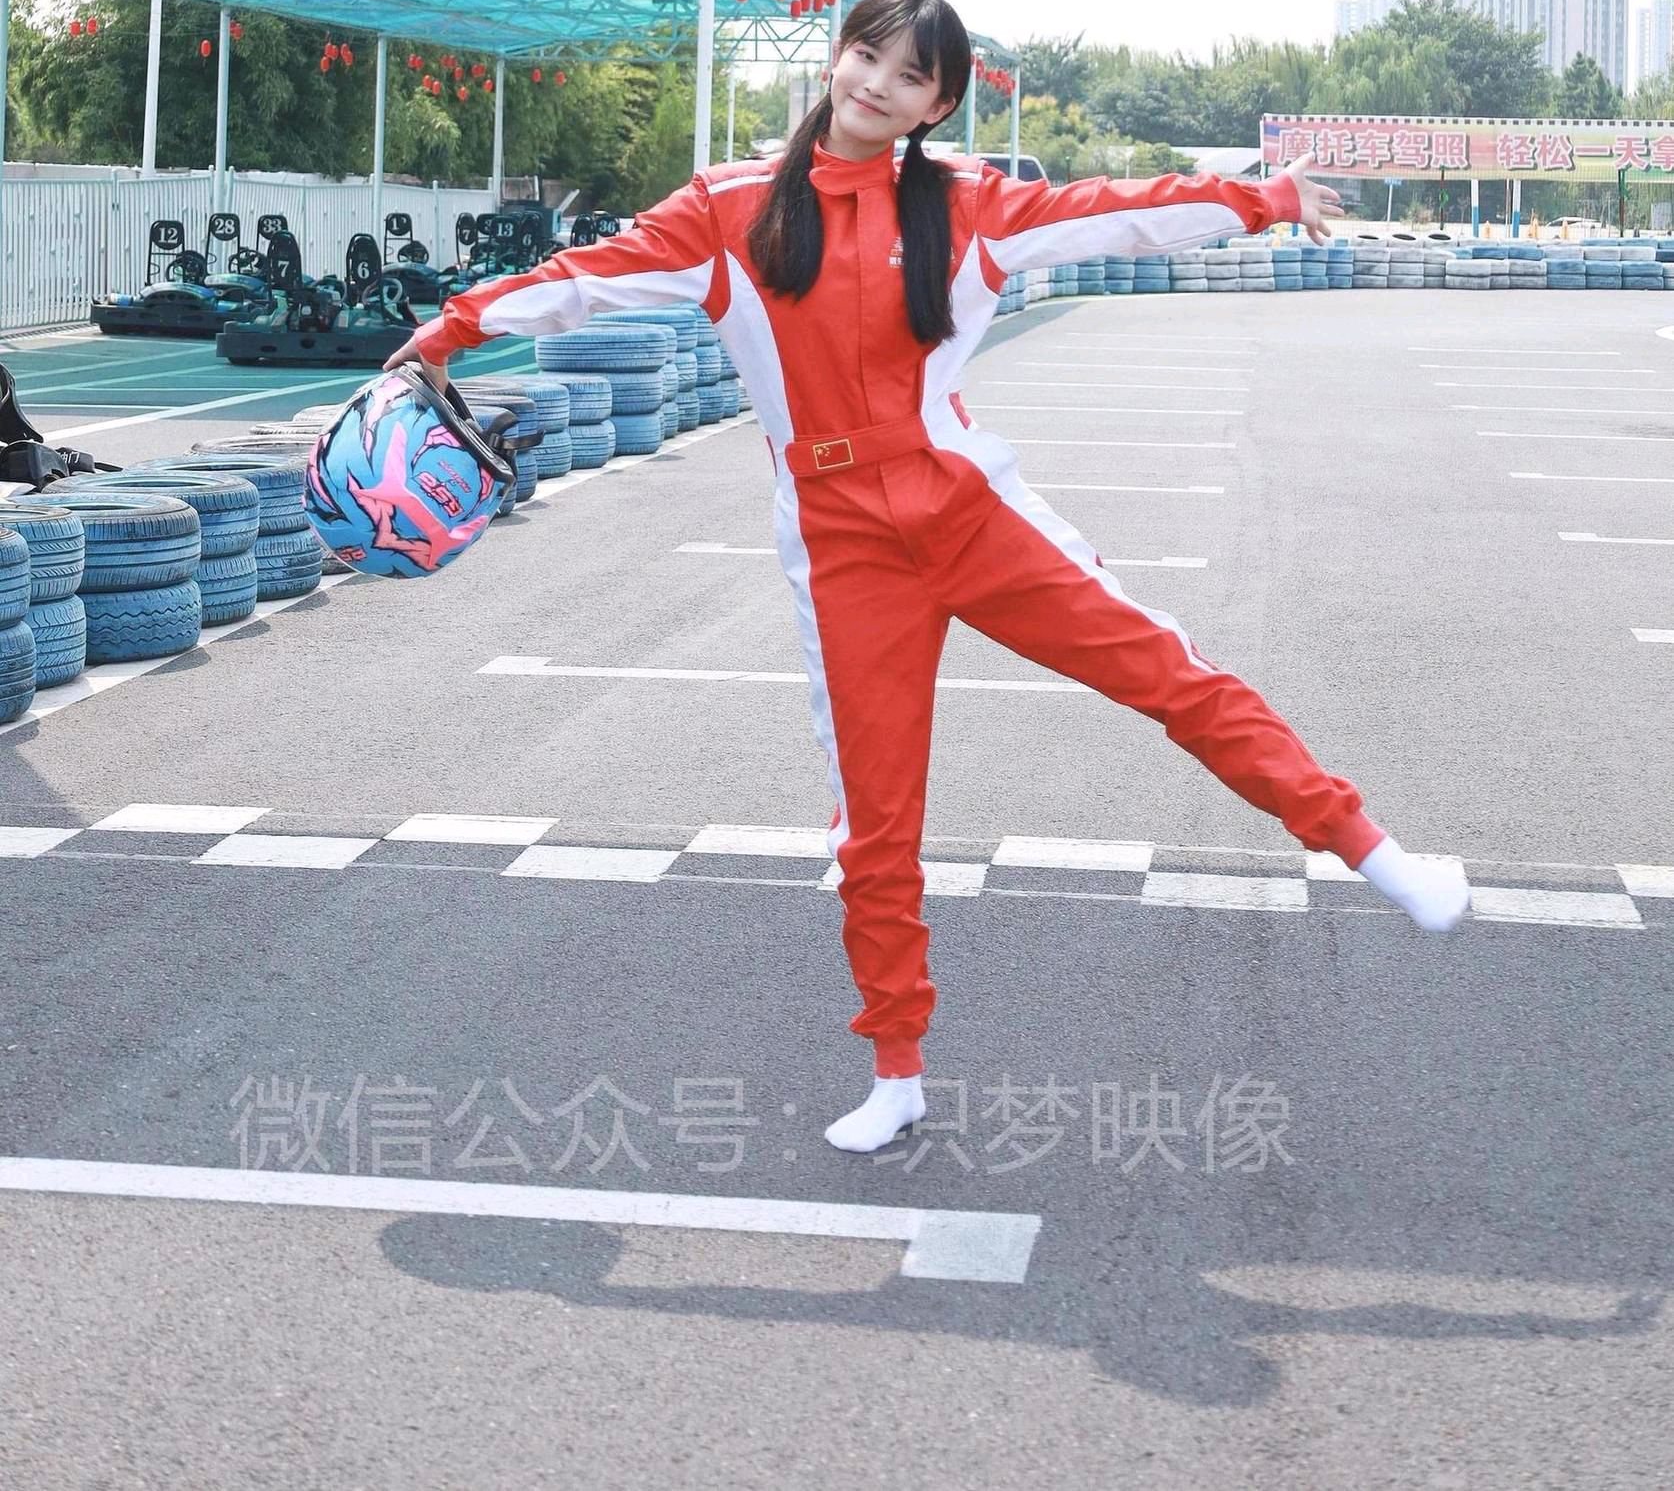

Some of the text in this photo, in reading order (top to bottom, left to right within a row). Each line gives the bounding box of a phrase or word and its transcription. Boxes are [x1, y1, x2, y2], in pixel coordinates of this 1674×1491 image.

[1278, 128, 1469, 170] 摩托车驾照
[214, 218, 235, 234] 28
[263, 219, 281, 233] 33
[497, 222, 514, 237] 13
[599, 220, 616, 233] 36
[158, 227, 178, 243] 12
[462, 229, 471, 240] 7
[522, 234, 532, 246] 6
[278, 260, 290, 277] 7
[357, 262, 369, 279] 6
